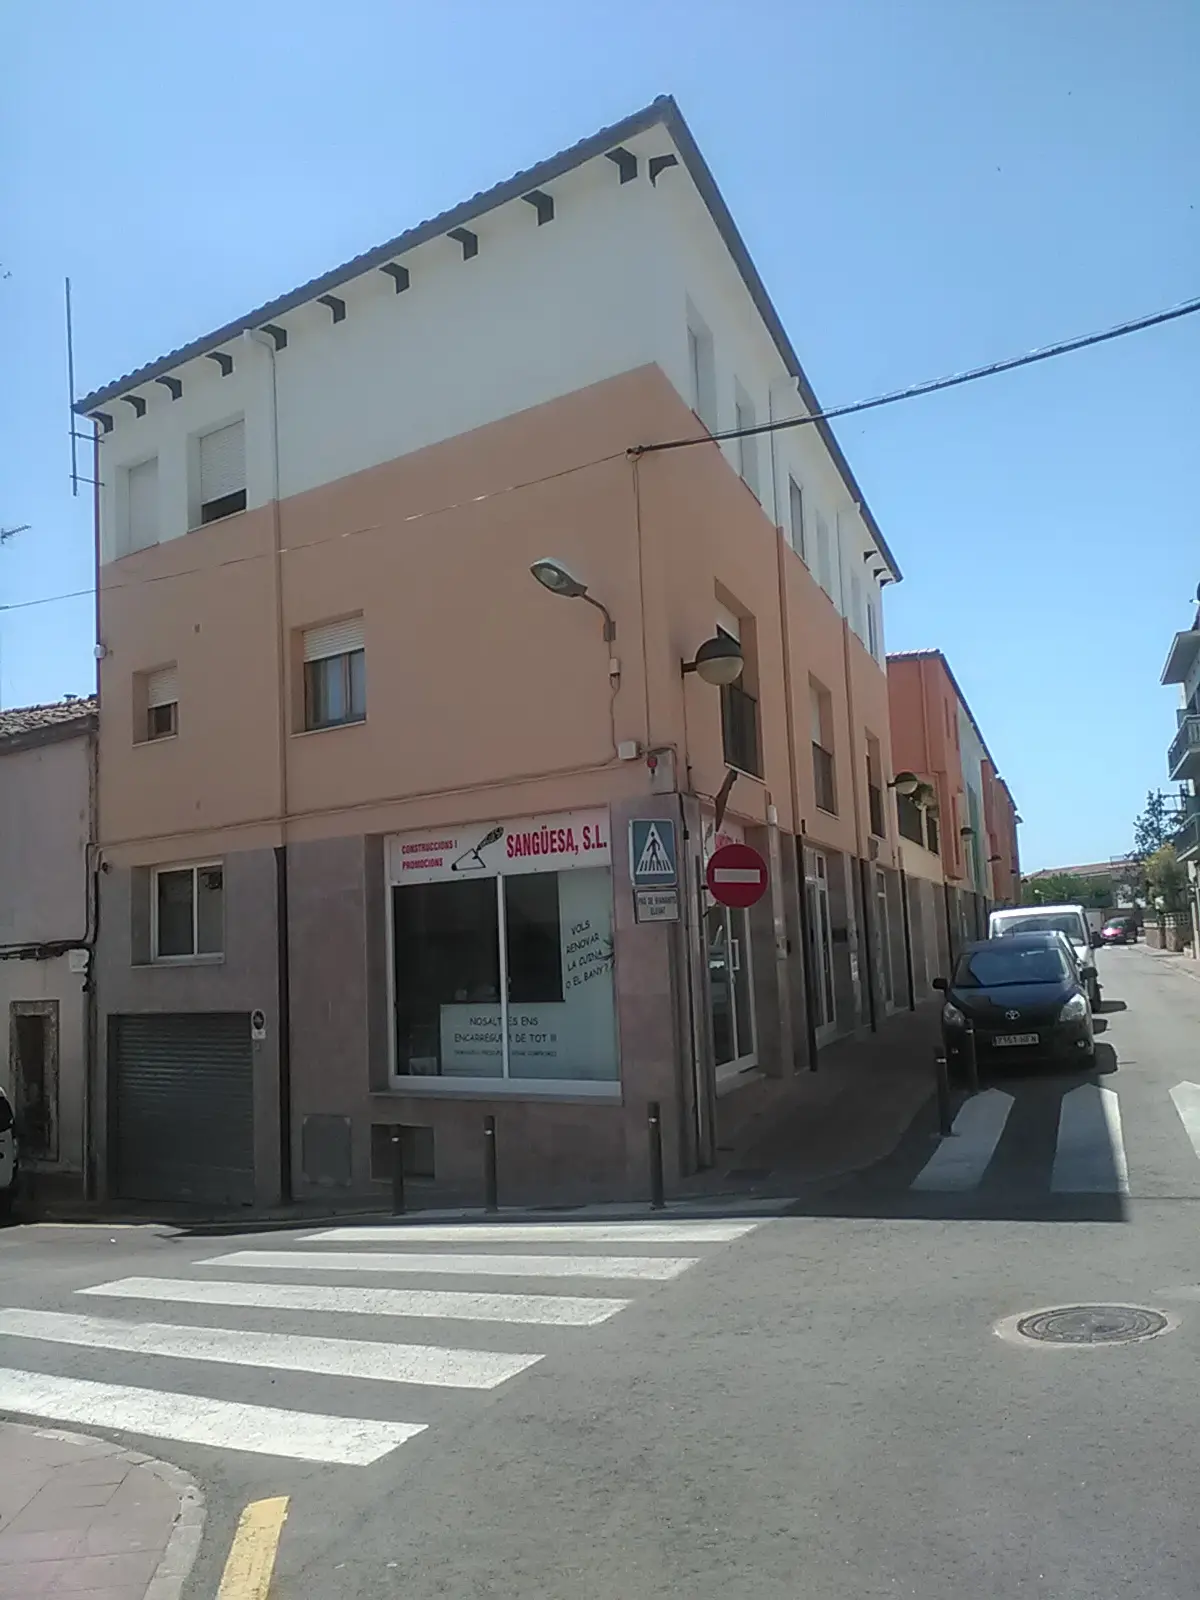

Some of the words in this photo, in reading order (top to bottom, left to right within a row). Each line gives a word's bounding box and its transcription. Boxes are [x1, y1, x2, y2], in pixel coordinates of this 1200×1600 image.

[402, 841, 453, 854] CONSTRUCCIONS
[506, 826, 579, 858] SANGÜESA,
[582, 825, 608, 850] S.L.
[402, 858, 443, 870] PROMOCIONS
[571, 919, 590, 935] VOLS
[566, 932, 600, 954] RENOVAR
[567, 961, 576, 972] LA
[573, 975, 581, 986] EL
[469, 1017, 518, 1026] NOSALTES
[521, 1017, 539, 1026] ENS
[515, 1033, 526, 1043] DE
[529, 1033, 547, 1043] TOT
